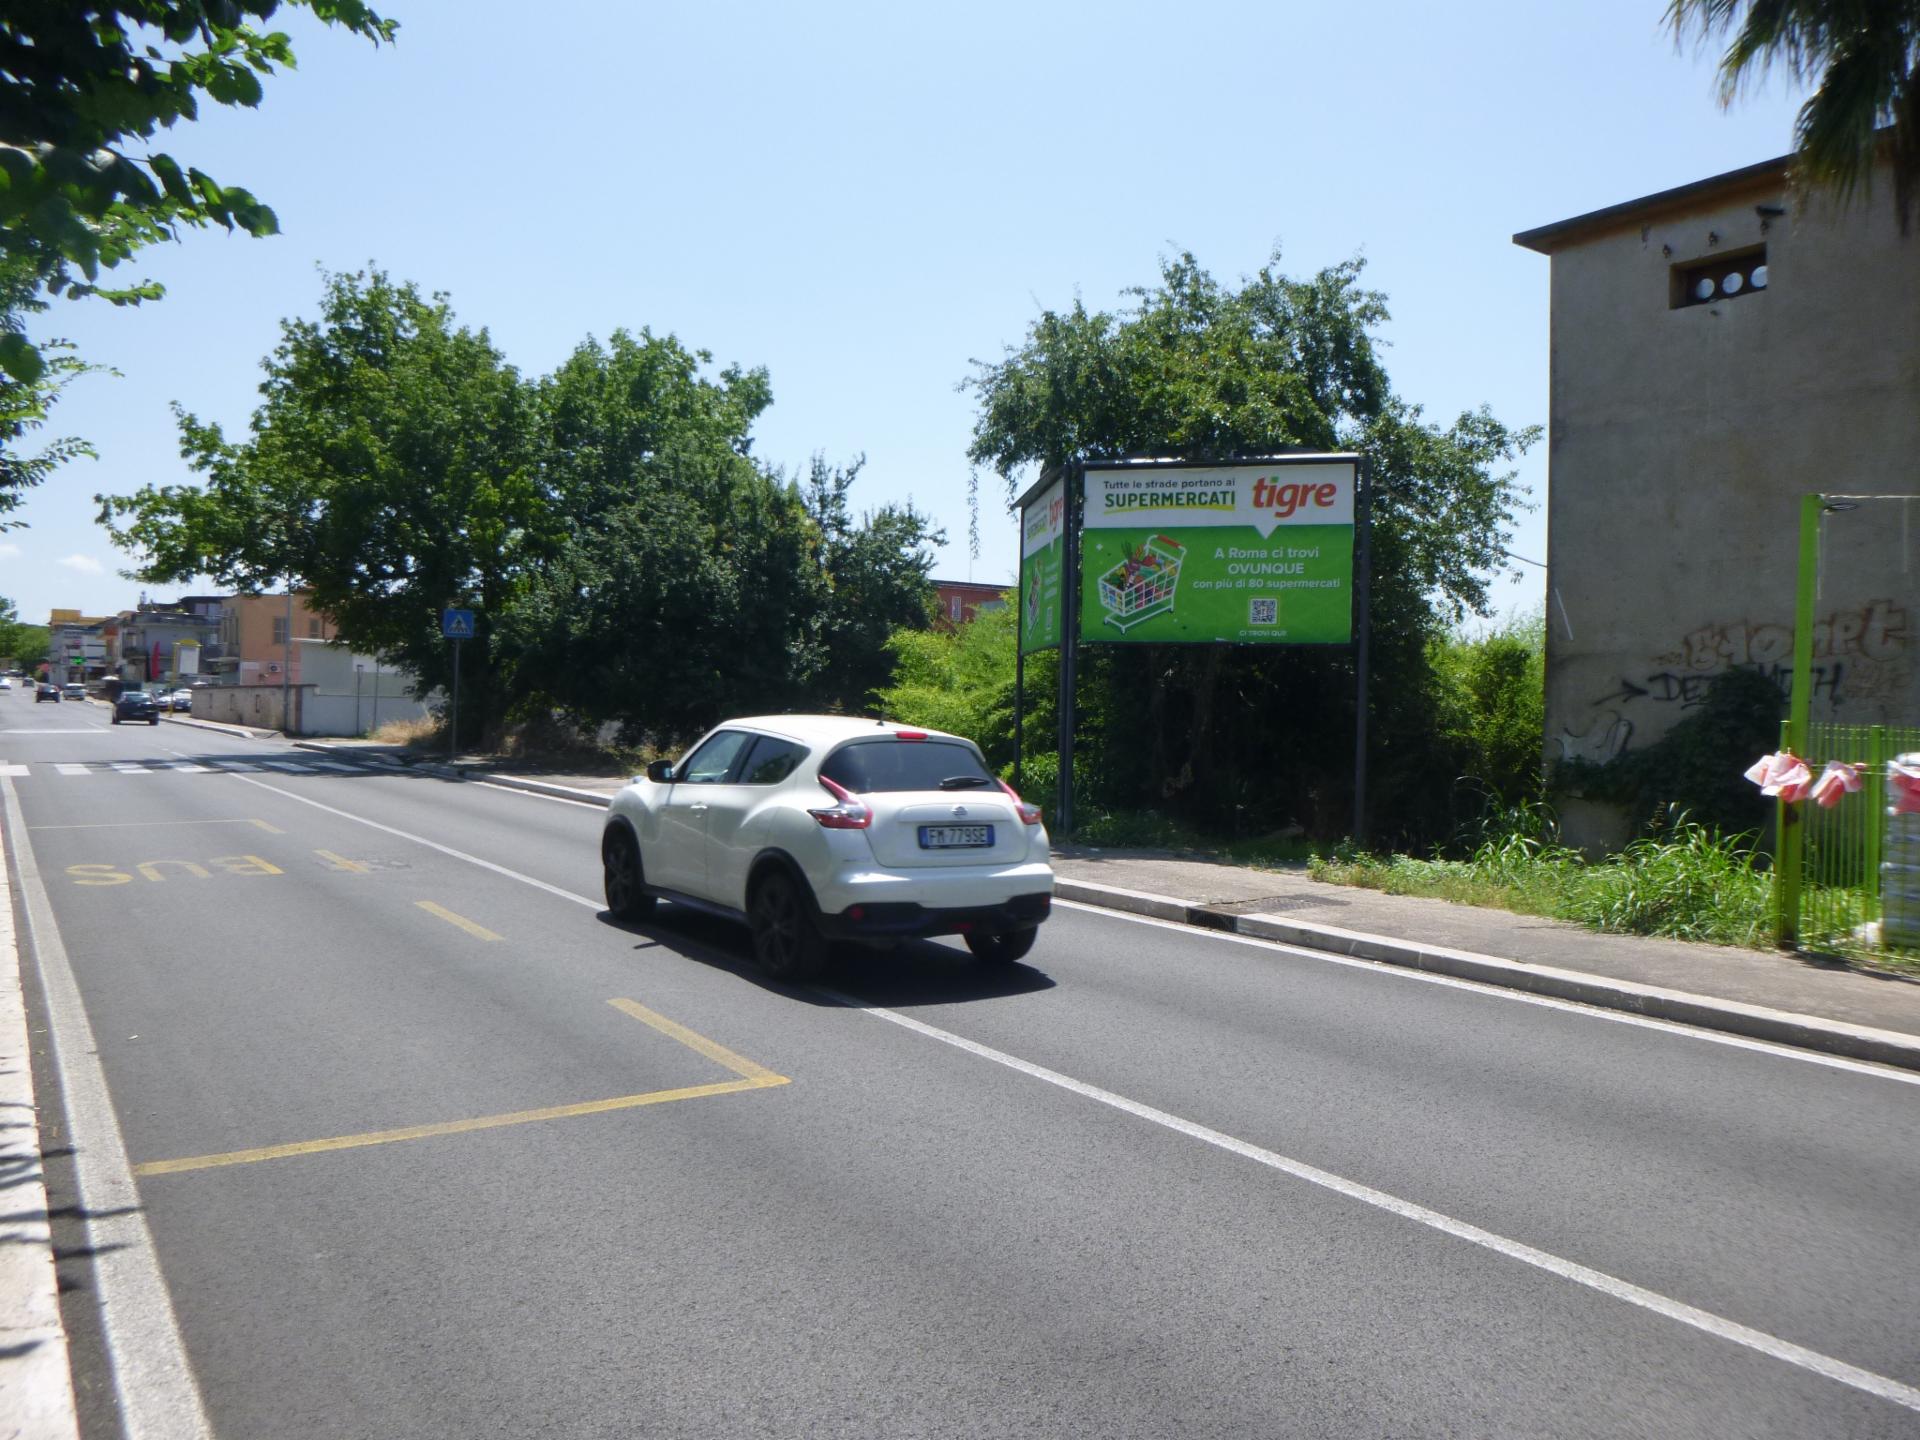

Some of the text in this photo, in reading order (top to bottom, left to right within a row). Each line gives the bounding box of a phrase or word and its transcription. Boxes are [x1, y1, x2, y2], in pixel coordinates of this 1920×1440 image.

[1103, 477, 1236, 490] Tutte le strade portano ai
[1104, 491, 1236, 508] SUPERMERCATI
[1253, 476, 1337, 518] tigre
[1214, 547, 1320, 559] A Roma ci trovi
[1228, 562, 1305, 575] OVUNQUE
[1192, 577, 1341, 590] con più di 80 supermercati
